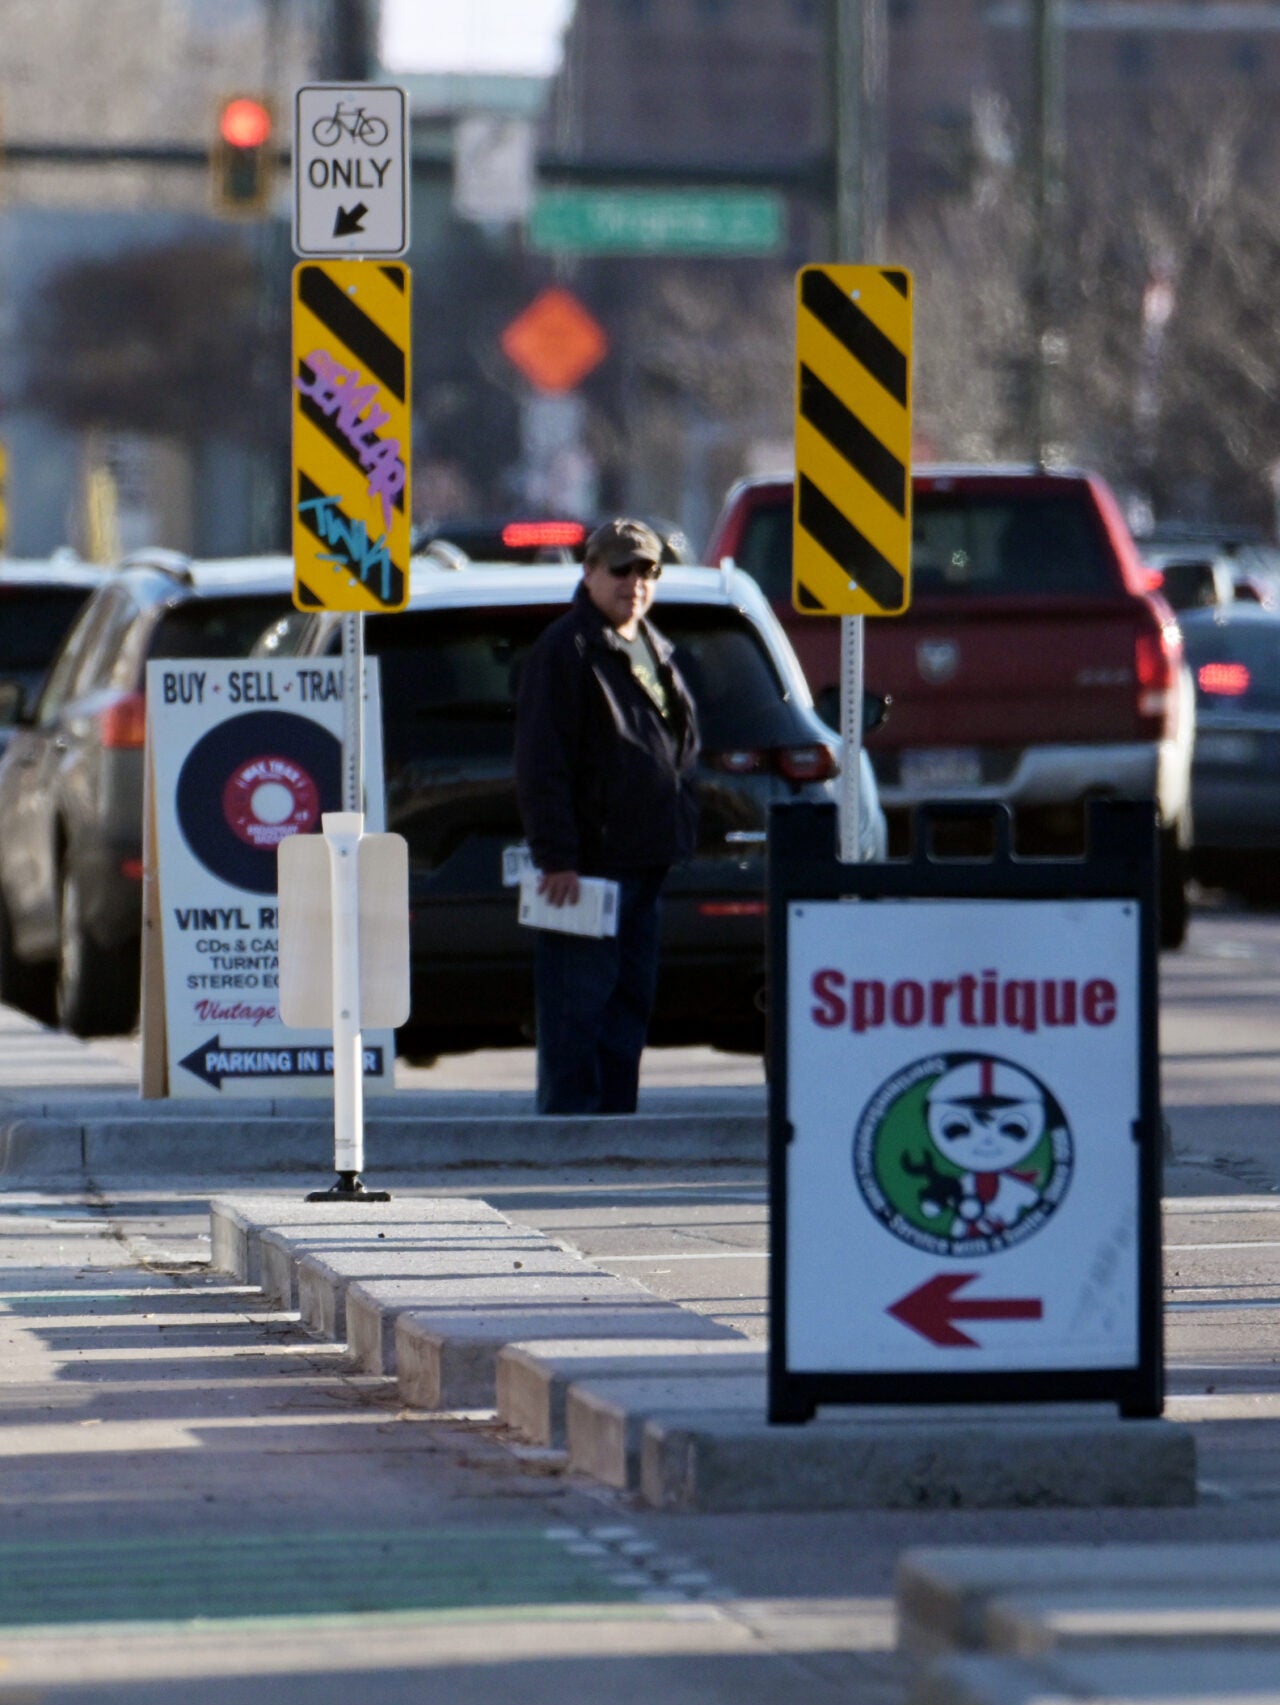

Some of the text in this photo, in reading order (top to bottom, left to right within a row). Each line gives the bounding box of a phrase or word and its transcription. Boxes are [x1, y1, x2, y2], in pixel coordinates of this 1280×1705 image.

[309, 158, 392, 188] ONLY
[163, 672, 207, 703] BUY
[228, 671, 279, 703] SELL
[174, 908, 279, 930] VINYL R
[196, 939, 279, 953] CDs & CA
[187, 974, 259, 989] STEREO
[194, 999, 277, 1027] Vintage
[811, 968, 1118, 1033] Sportique
[206, 1050, 377, 1072] PARKING IN RR
